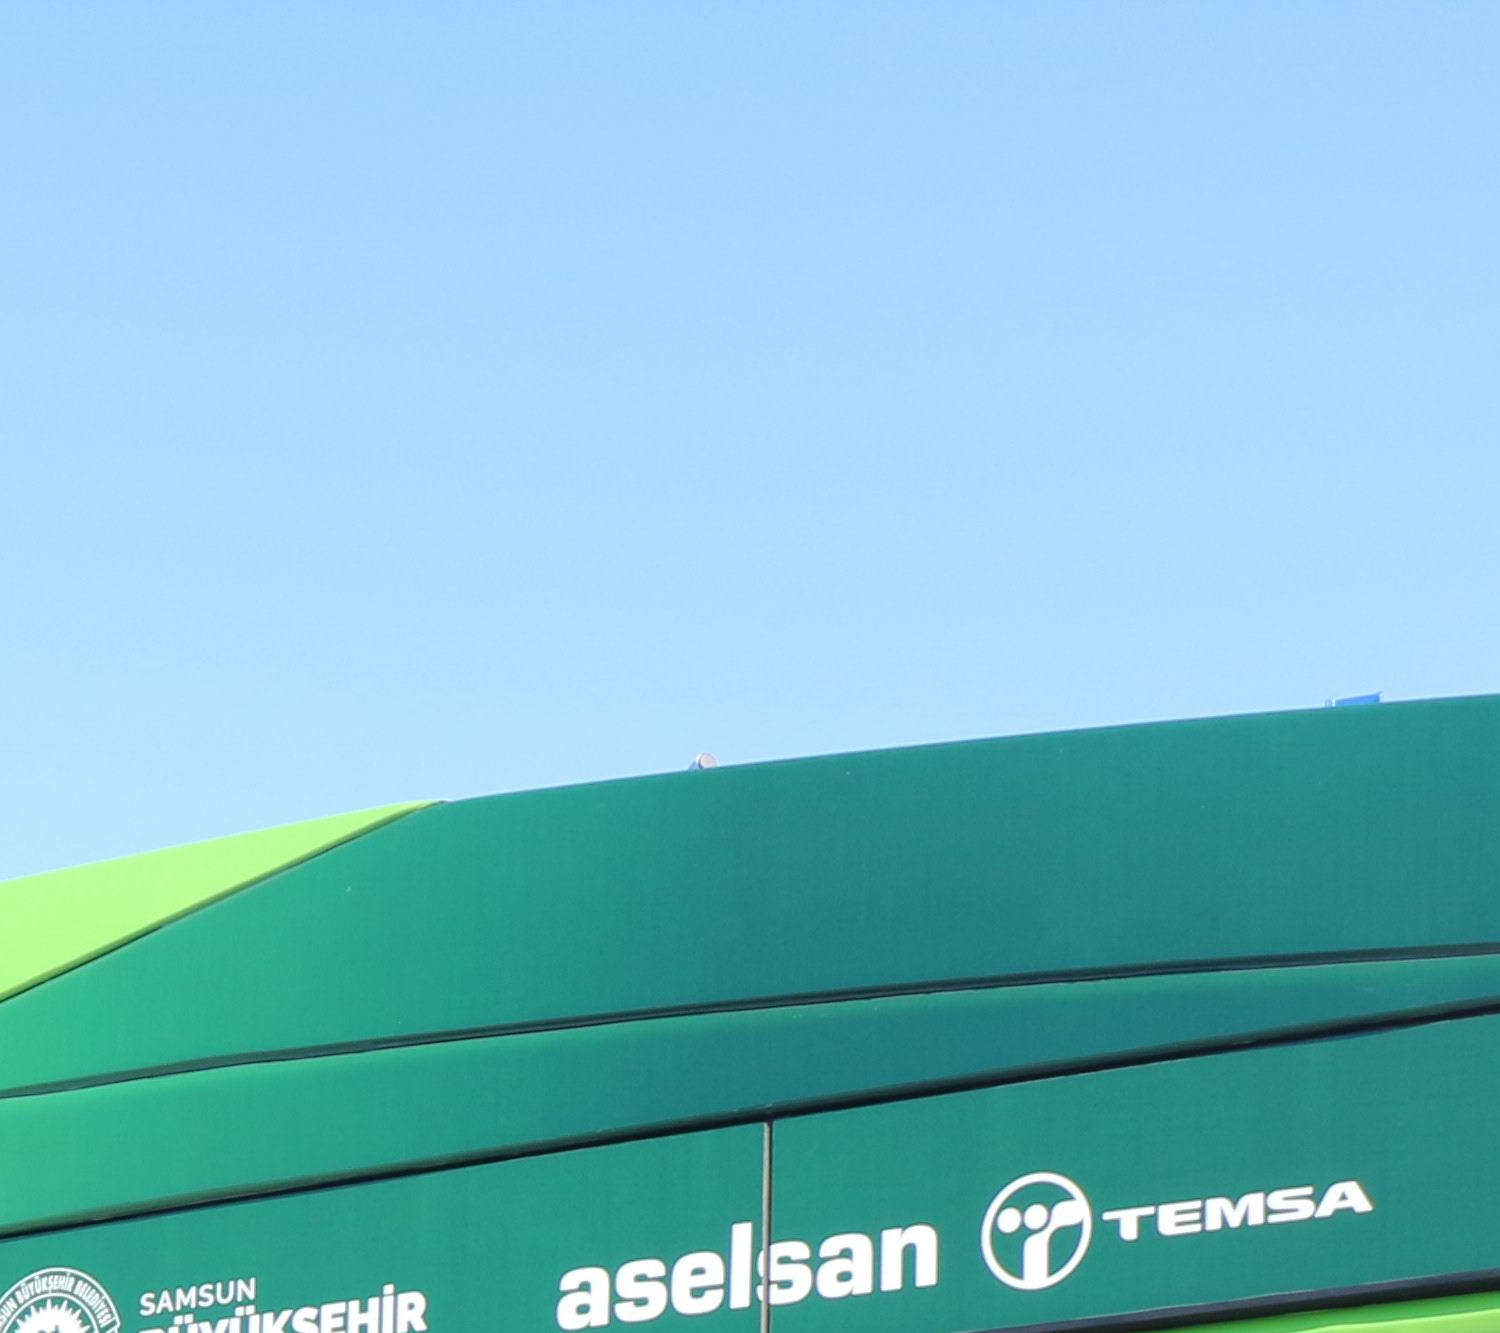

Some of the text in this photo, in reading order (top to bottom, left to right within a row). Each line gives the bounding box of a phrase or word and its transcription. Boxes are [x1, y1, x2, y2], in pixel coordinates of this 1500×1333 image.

[1102, 1181, 1373, 1240] TEMSA
[140, 1278, 255, 1317] SAMSUN
[557, 1222, 937, 1330] aselsan
